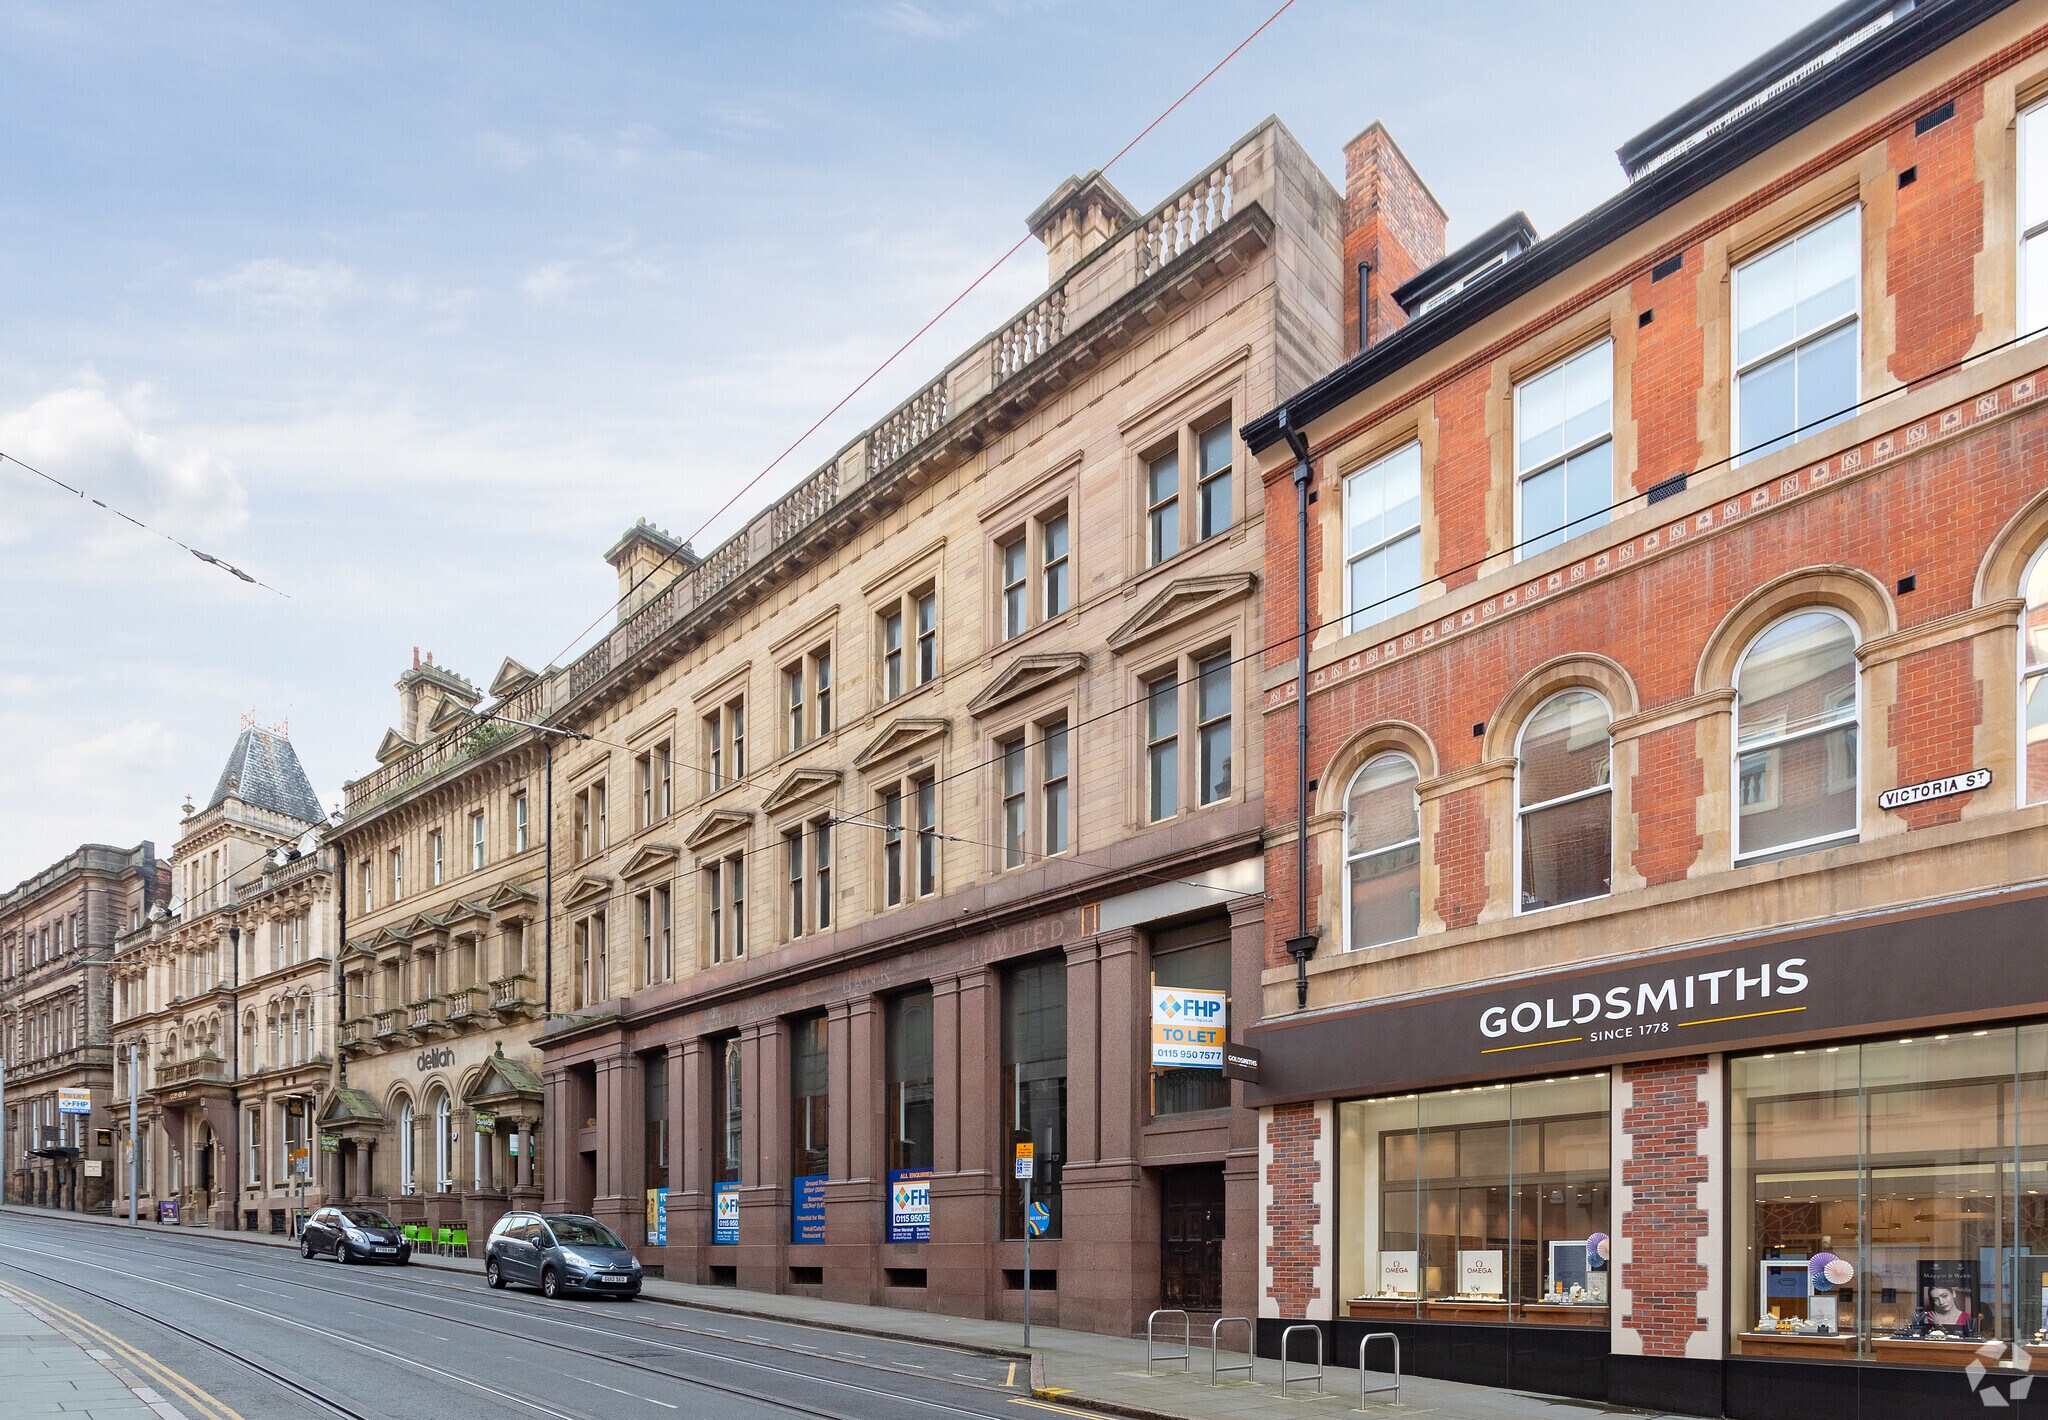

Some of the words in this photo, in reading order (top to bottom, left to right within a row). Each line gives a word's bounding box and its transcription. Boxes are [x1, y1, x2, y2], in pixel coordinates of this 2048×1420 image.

[1886, 779, 1958, 805] VICTORIA
[971, 920, 1064, 961] LIMITED
[1479, 958, 1809, 1038] GOLDSMITHS
[1183, 999, 1221, 1018] FHP
[1163, 1028, 1184, 1041] TO
[1188, 1030, 1217, 1043] LET
[1590, 1027, 1633, 1042] SINCE
[1638, 1022, 1670, 1037] 1778
[417, 1046, 455, 1072] delilah
[1158, 1049, 1178, 1058] 0115
[1180, 1050, 1198, 1059] 950
[1200, 1052, 1222, 1060] 7577
[1228, 1055, 1257, 1067] GOLDSMITHS
[896, 1215, 909, 1223] 0115
